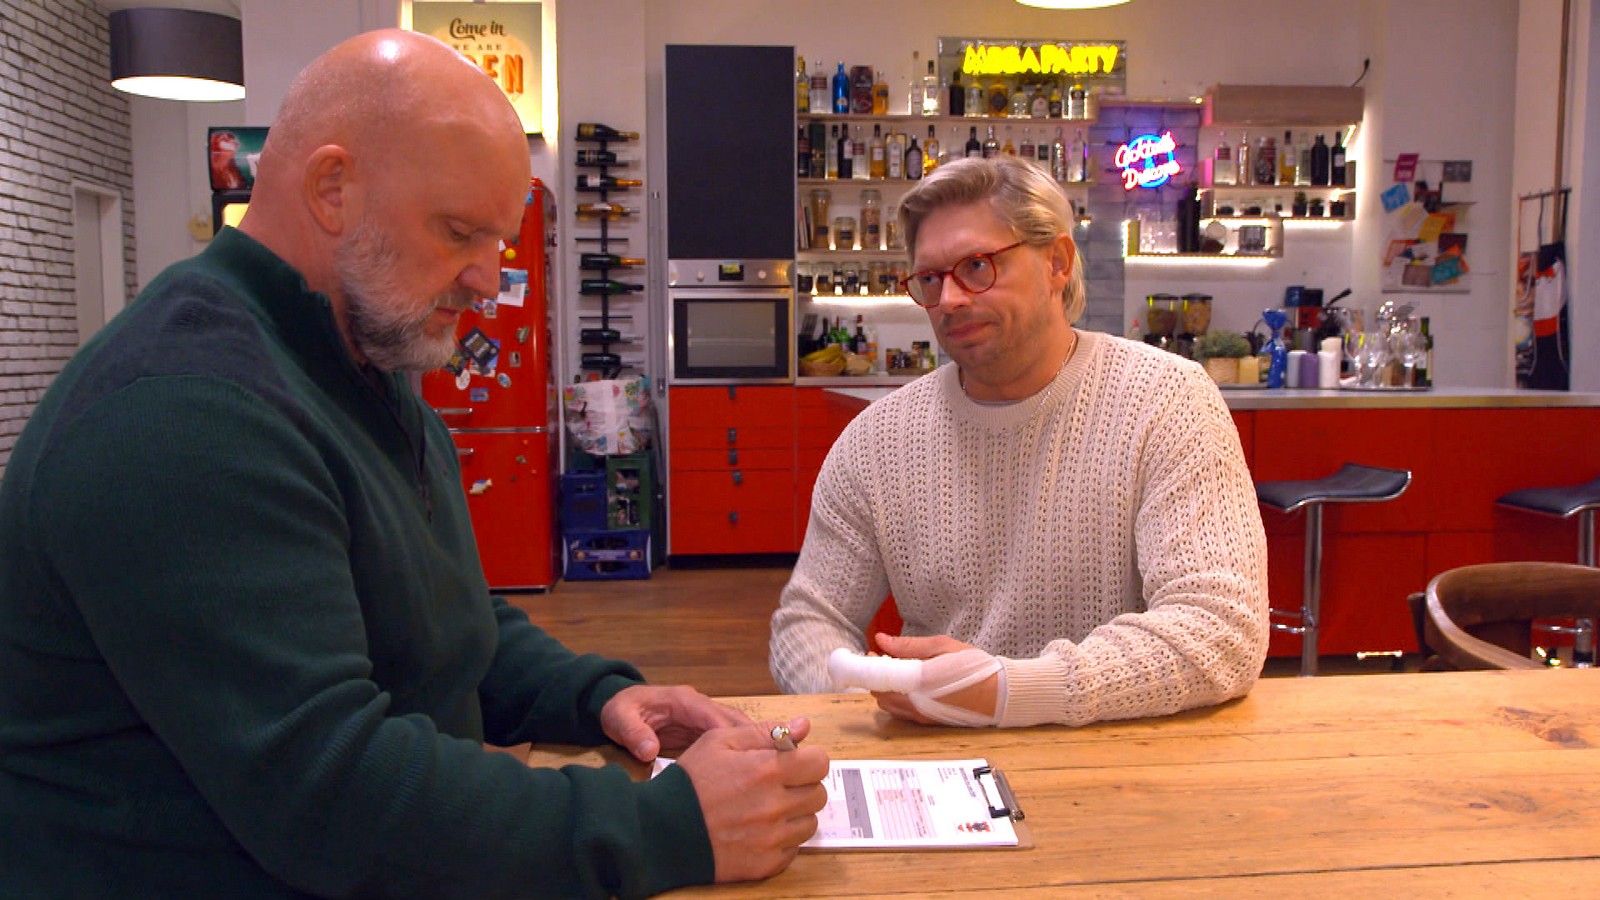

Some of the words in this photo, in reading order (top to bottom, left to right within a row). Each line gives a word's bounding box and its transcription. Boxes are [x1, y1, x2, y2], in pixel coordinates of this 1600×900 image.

[450, 18, 485, 40] Come
[490, 20, 505, 37] in
[464, 54, 523, 94] EN
